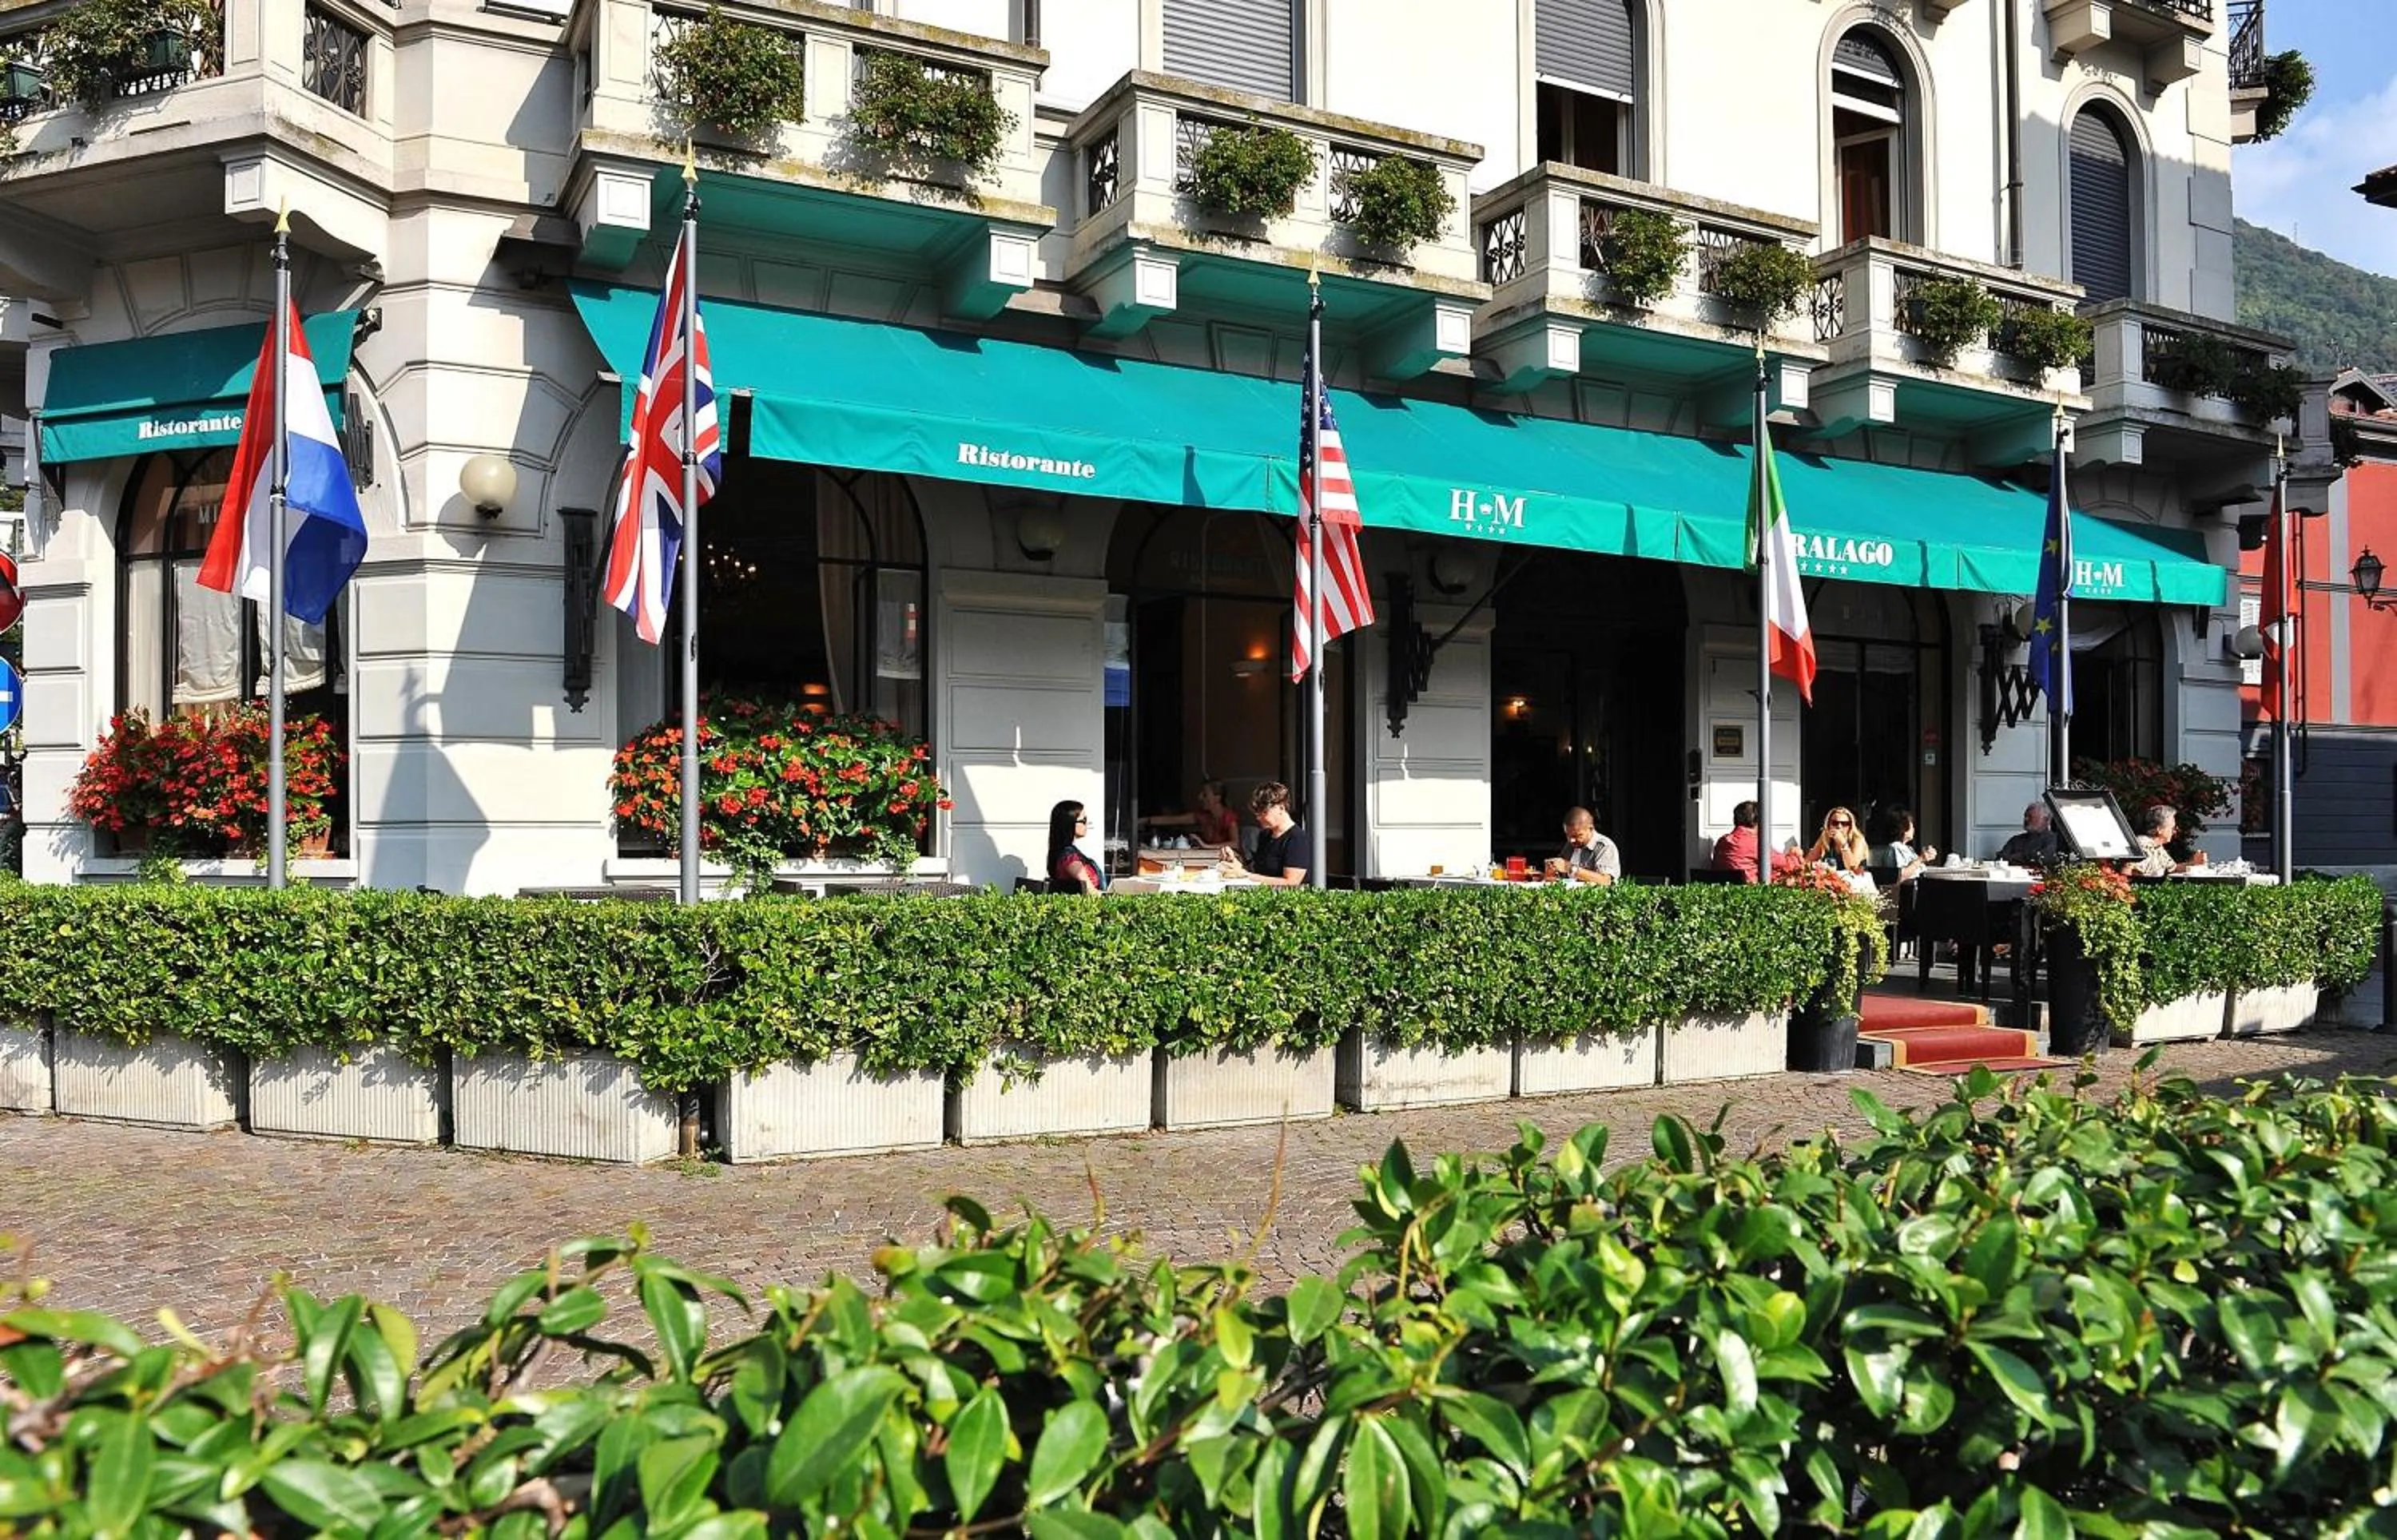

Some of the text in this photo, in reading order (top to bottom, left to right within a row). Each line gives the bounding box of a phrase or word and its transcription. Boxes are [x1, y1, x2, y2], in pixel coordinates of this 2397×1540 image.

[138, 414, 242, 439] Ristorante
[956, 443, 1096, 478] Ristorante
[1789, 533, 1893, 566] RALAGO
